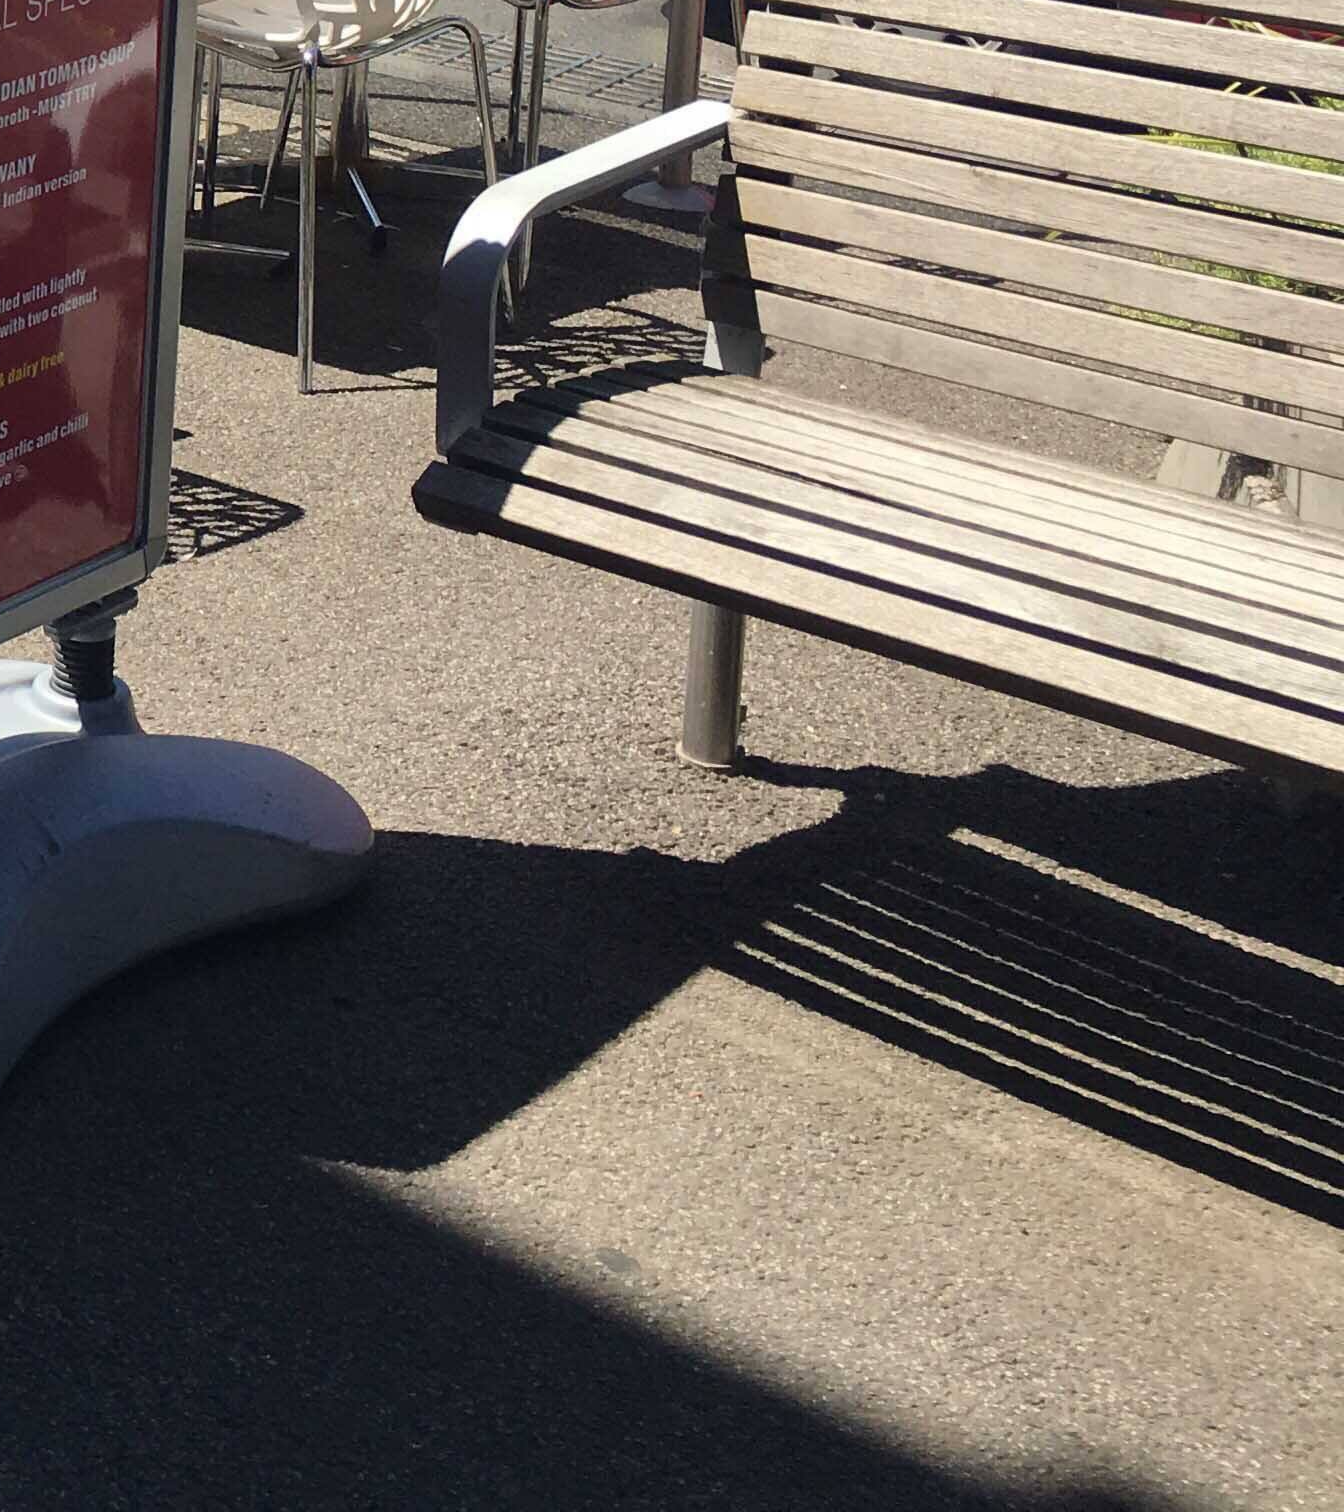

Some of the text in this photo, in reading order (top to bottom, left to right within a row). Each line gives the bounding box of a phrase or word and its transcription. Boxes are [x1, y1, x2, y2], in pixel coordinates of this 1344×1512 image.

[39, 54, 96, 90] TOMATO
[98, 40, 136, 69] SOUP
[73, 81, 97, 102] TRY
[3, 182, 42, 209] Indian
[44, 167, 87, 193] version
[21, 283, 49, 307] with
[50, 268, 87, 295] lightly
[0, 315, 26, 339] with
[27, 308, 50, 329] two
[50, 286, 99, 318] coconut
[7, 360, 40, 386] dairy
[41, 350, 65, 373] free
[0, 438, 34, 468] garlic
[35, 425, 59, 449] and
[59, 413, 90, 439] chilli
